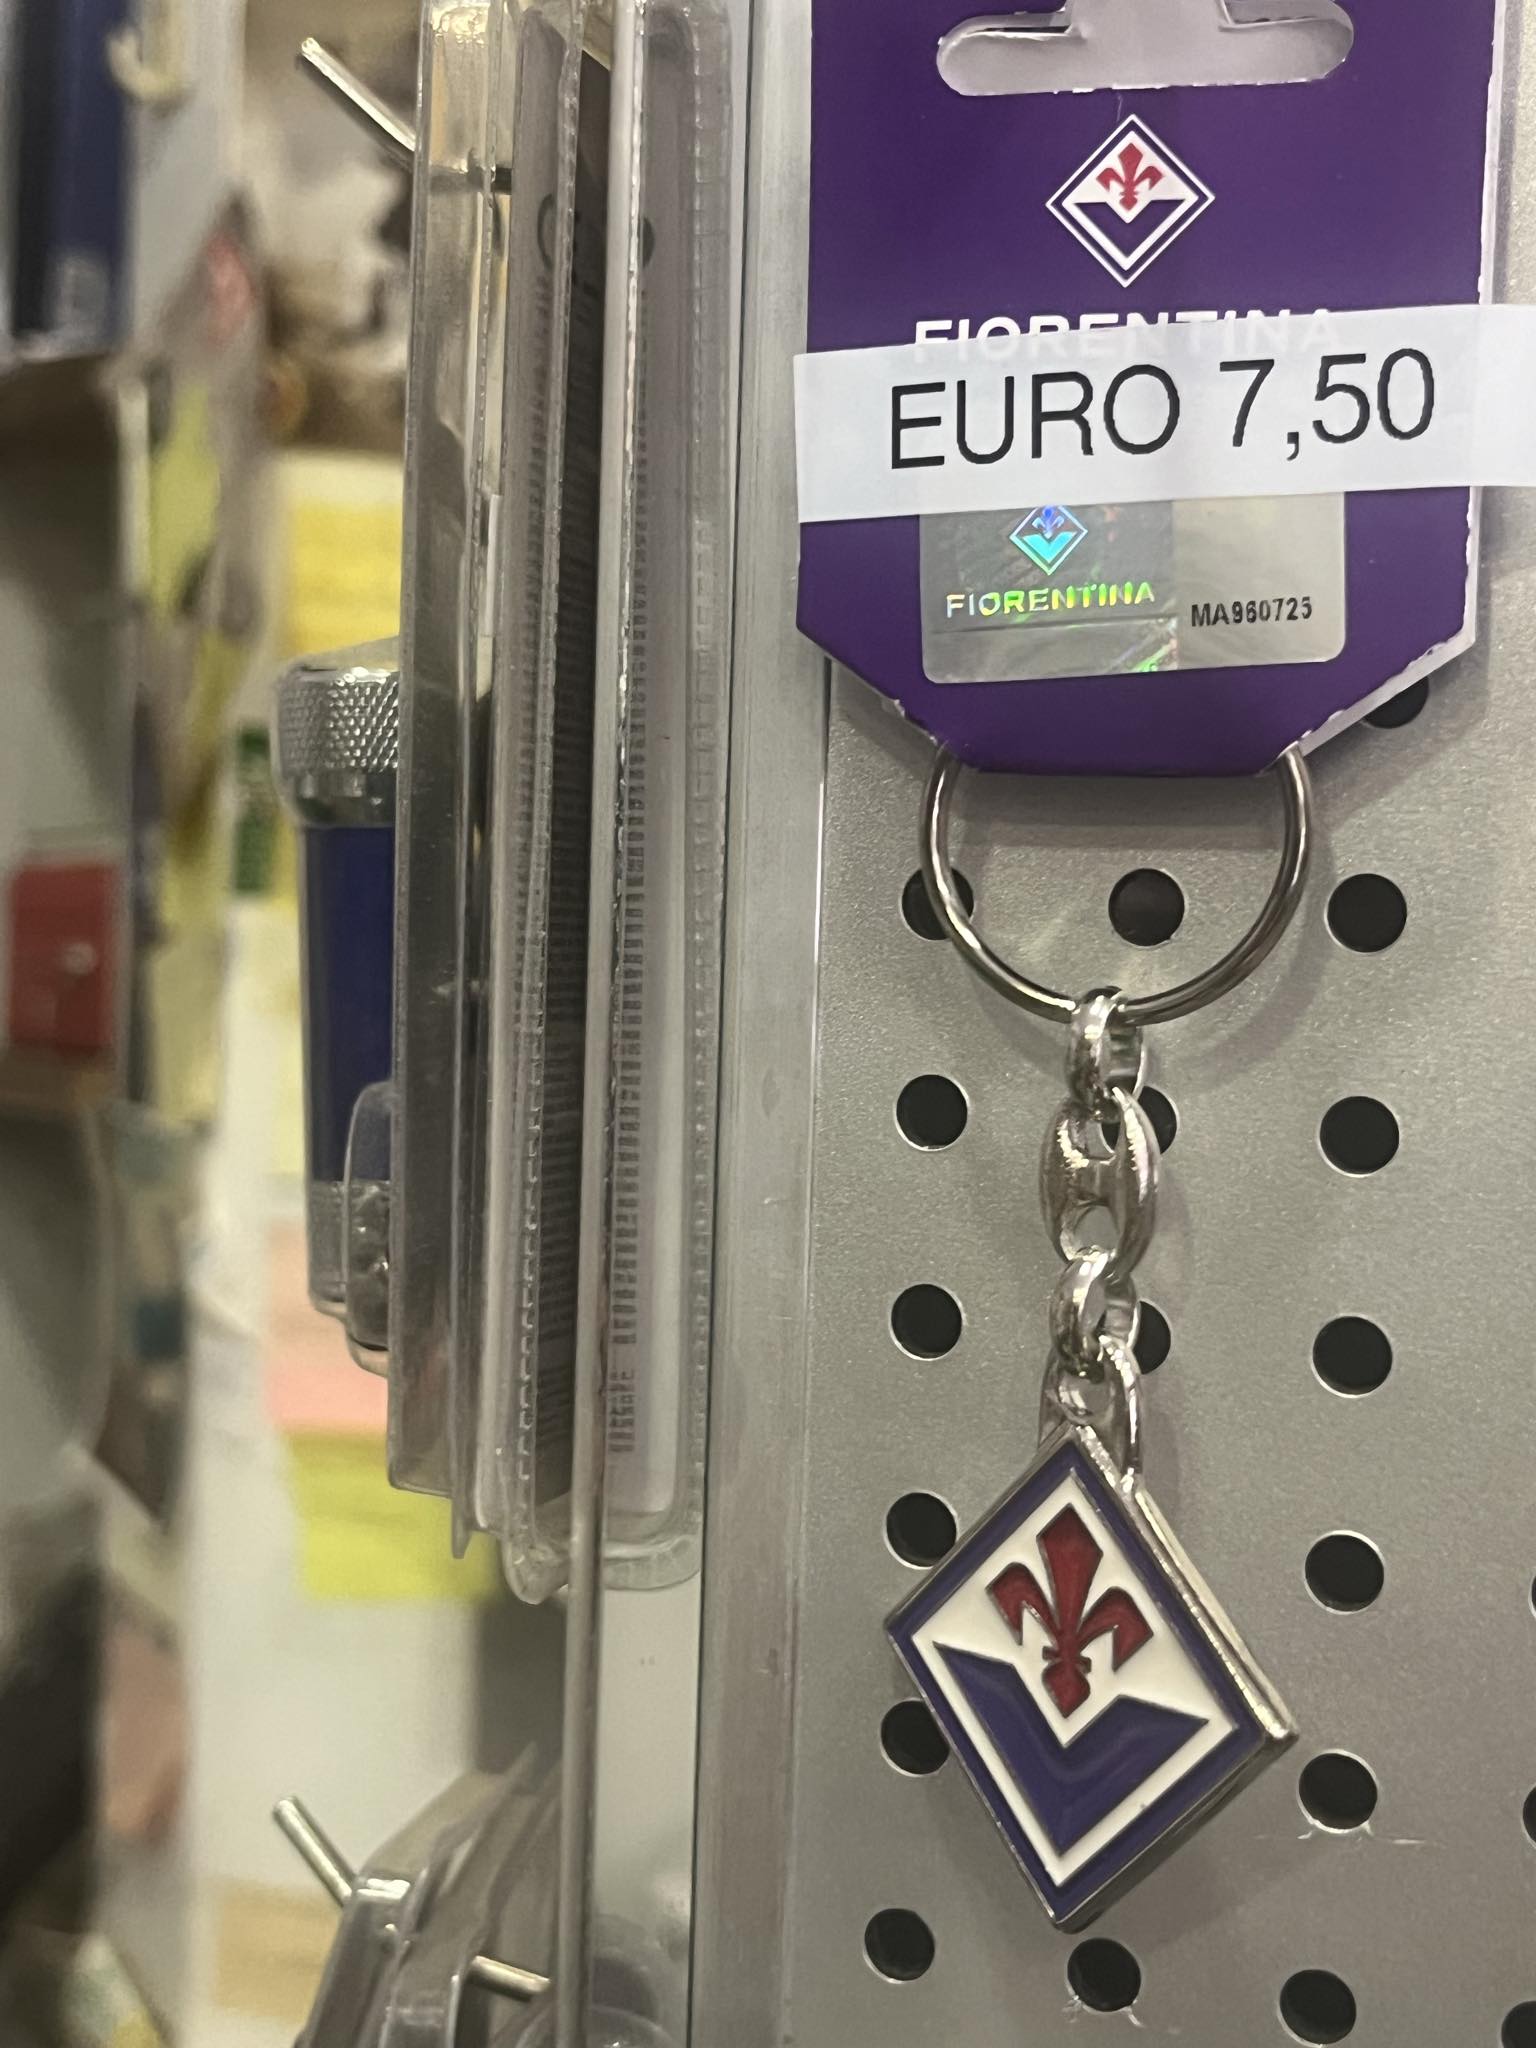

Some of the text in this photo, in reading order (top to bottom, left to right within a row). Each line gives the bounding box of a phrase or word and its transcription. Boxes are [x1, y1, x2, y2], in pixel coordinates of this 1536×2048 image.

[890, 347, 1436, 470] EURO 7,50
[946, 581, 1156, 618] FIORENTINA
